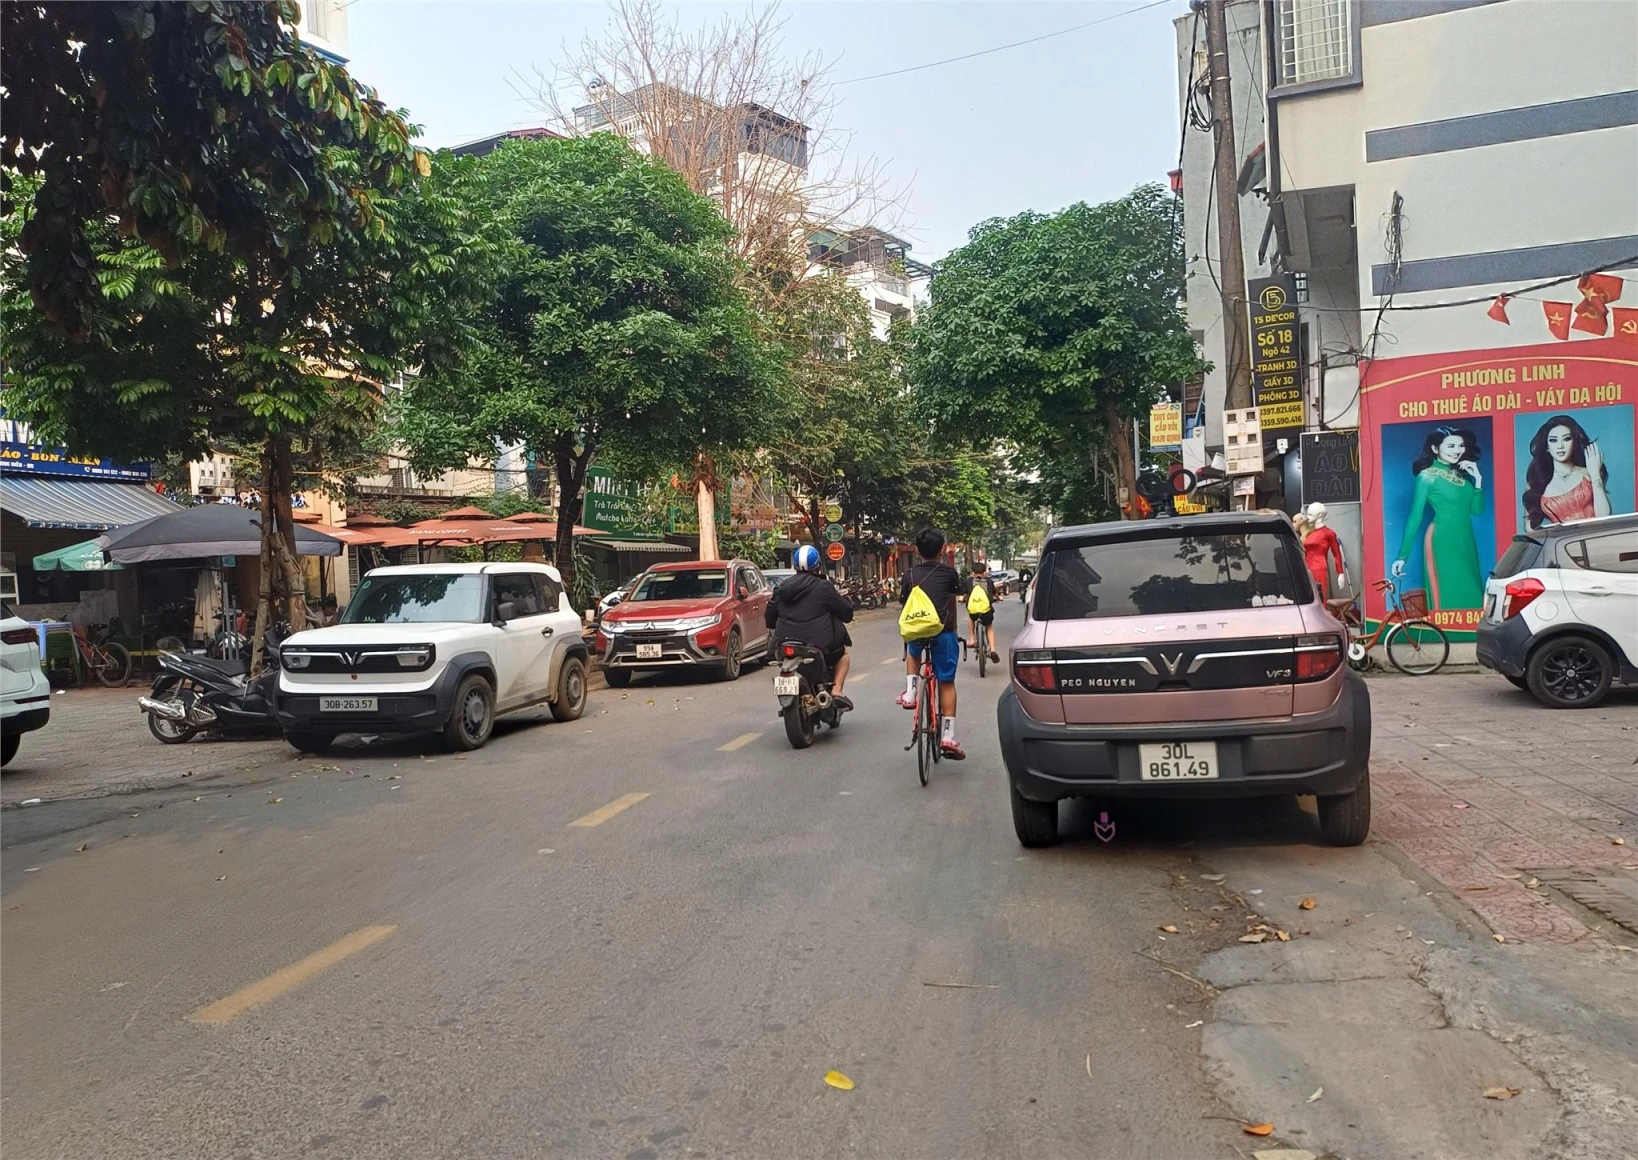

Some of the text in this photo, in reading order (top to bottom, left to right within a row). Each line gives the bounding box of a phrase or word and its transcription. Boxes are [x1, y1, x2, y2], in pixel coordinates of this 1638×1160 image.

[1254, 316, 1264, 324] TS
[1257, 329, 1293, 346] Số 18
[1262, 347, 1279, 357] Ngõ
[1257, 360, 1297, 372] TRANH 3D
[1263, 376, 1294, 387] GIẤY 3D
[1441, 364, 1565, 388] PHƯƠNG LINH
[1258, 390, 1300, 402] PHÔNG 3D
[1399, 401, 1428, 418] CHO
[1431, 395, 1468, 415] THUÊ
[1472, 392, 1492, 412] ÁO
[1496, 390, 1521, 410] DÀI
[1536, 387, 1565, 407] VÁY
[1570, 387, 1590, 407] DẠ
[1595, 381, 1622, 405] HỘI
[1313, 450, 1348, 473] ÁO
[1434, 612, 1463, 625] 0974
[1265, 668, 1292, 678] VF3
[1061, 678, 1136, 687] PEO NGUYEN
[324, 699, 373, 709] 30B-263.57
[1161, 744, 1195, 760] 30L
[1149, 761, 1210, 778] 861.49
